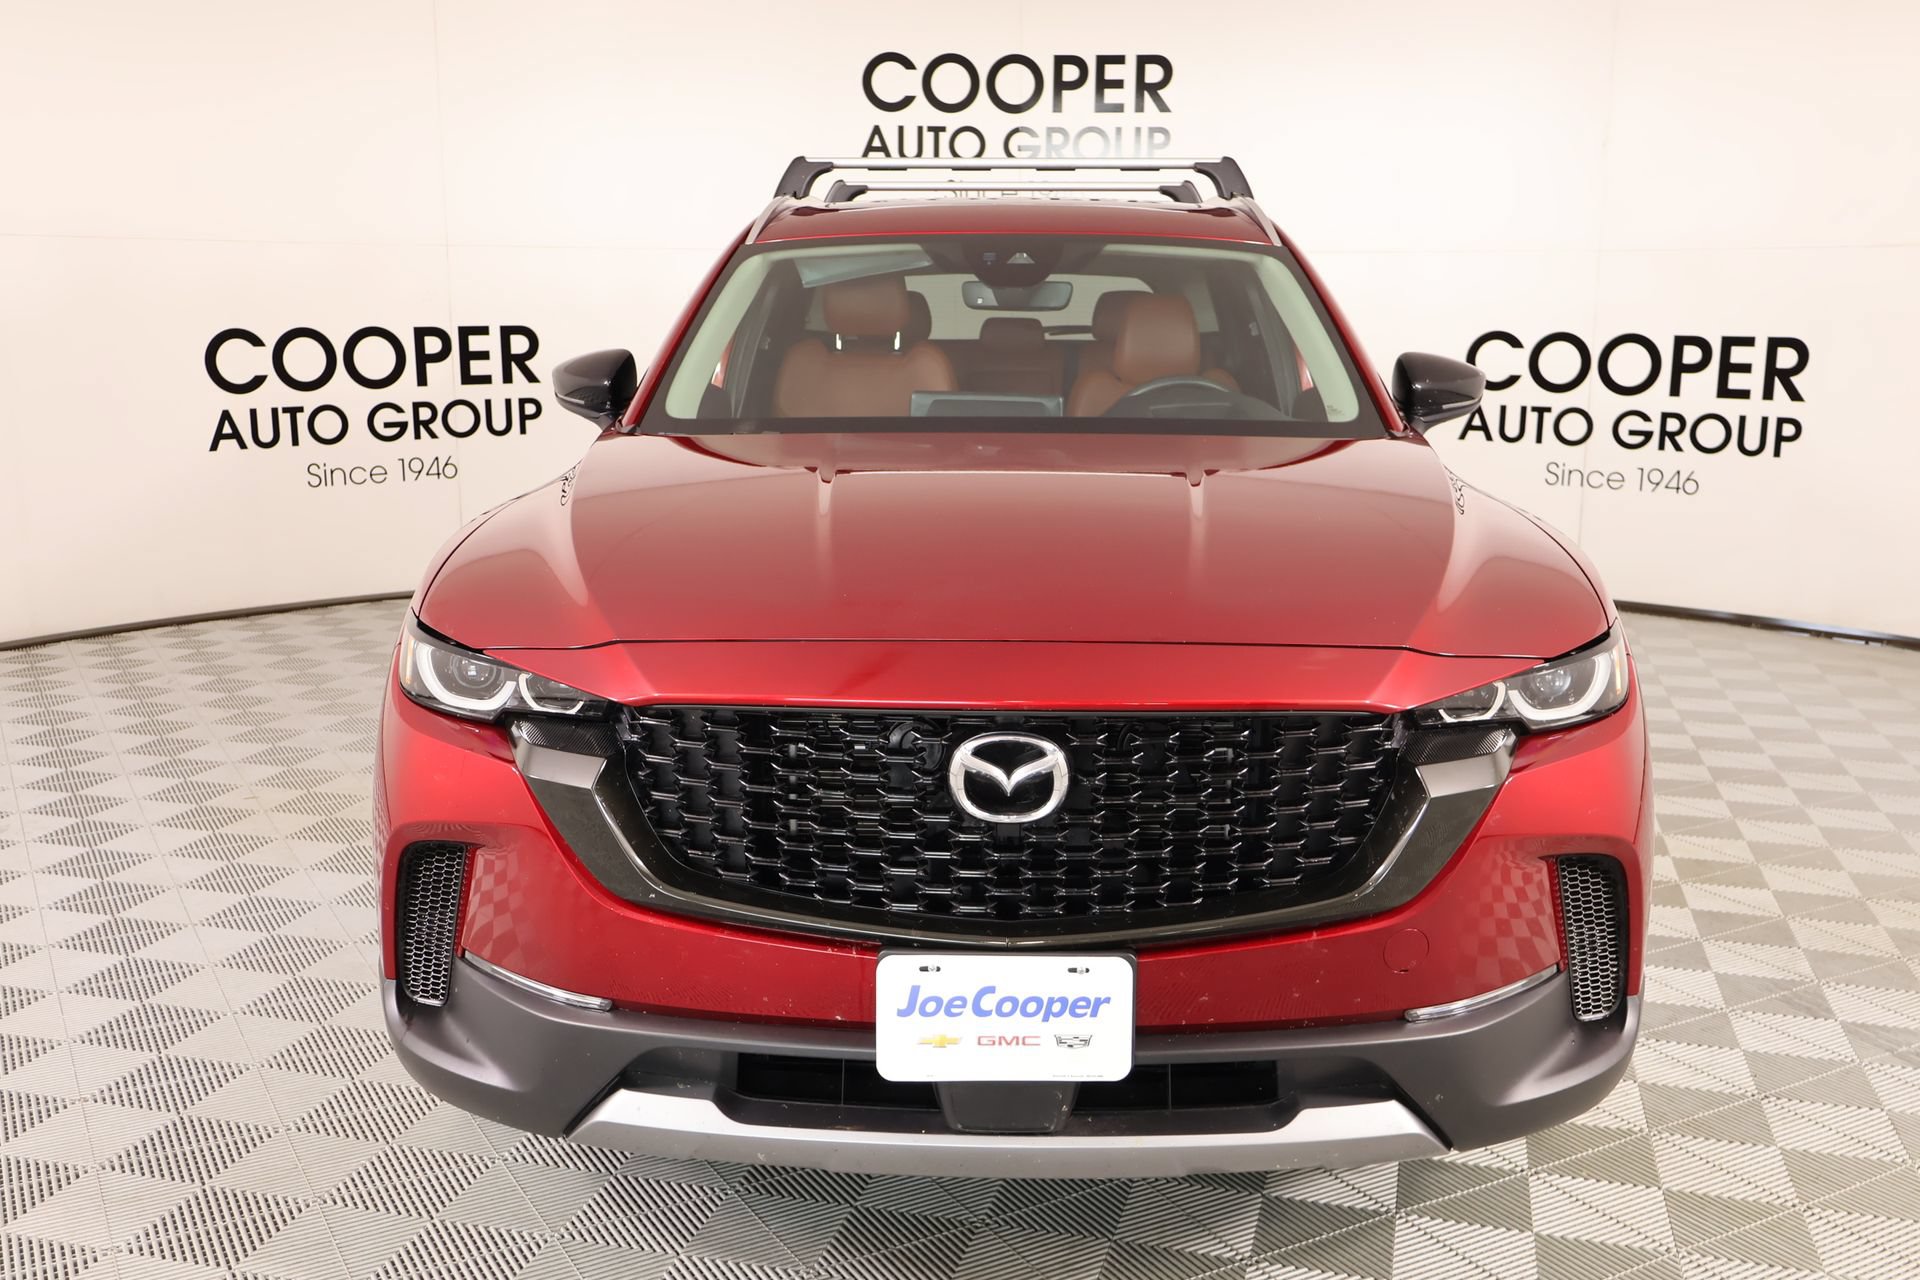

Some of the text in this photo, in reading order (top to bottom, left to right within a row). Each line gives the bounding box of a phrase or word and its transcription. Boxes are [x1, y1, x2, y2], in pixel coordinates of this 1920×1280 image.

[862, 52, 1173, 113] COOPER
[862, 125, 1172, 158] AUTO GROUP
[205, 325, 541, 395] COOPER
[1466, 331, 1810, 402] COOPER
[209, 398, 542, 452] AUTO GROUP
[1458, 405, 1803, 458] AUTO GROUP
[307, 456, 458, 488] Since 1946
[1545, 461, 1700, 496] Since 1946
[896, 985, 1112, 1023] Joe Cooper
[977, 1035, 1041, 1047] GMC
